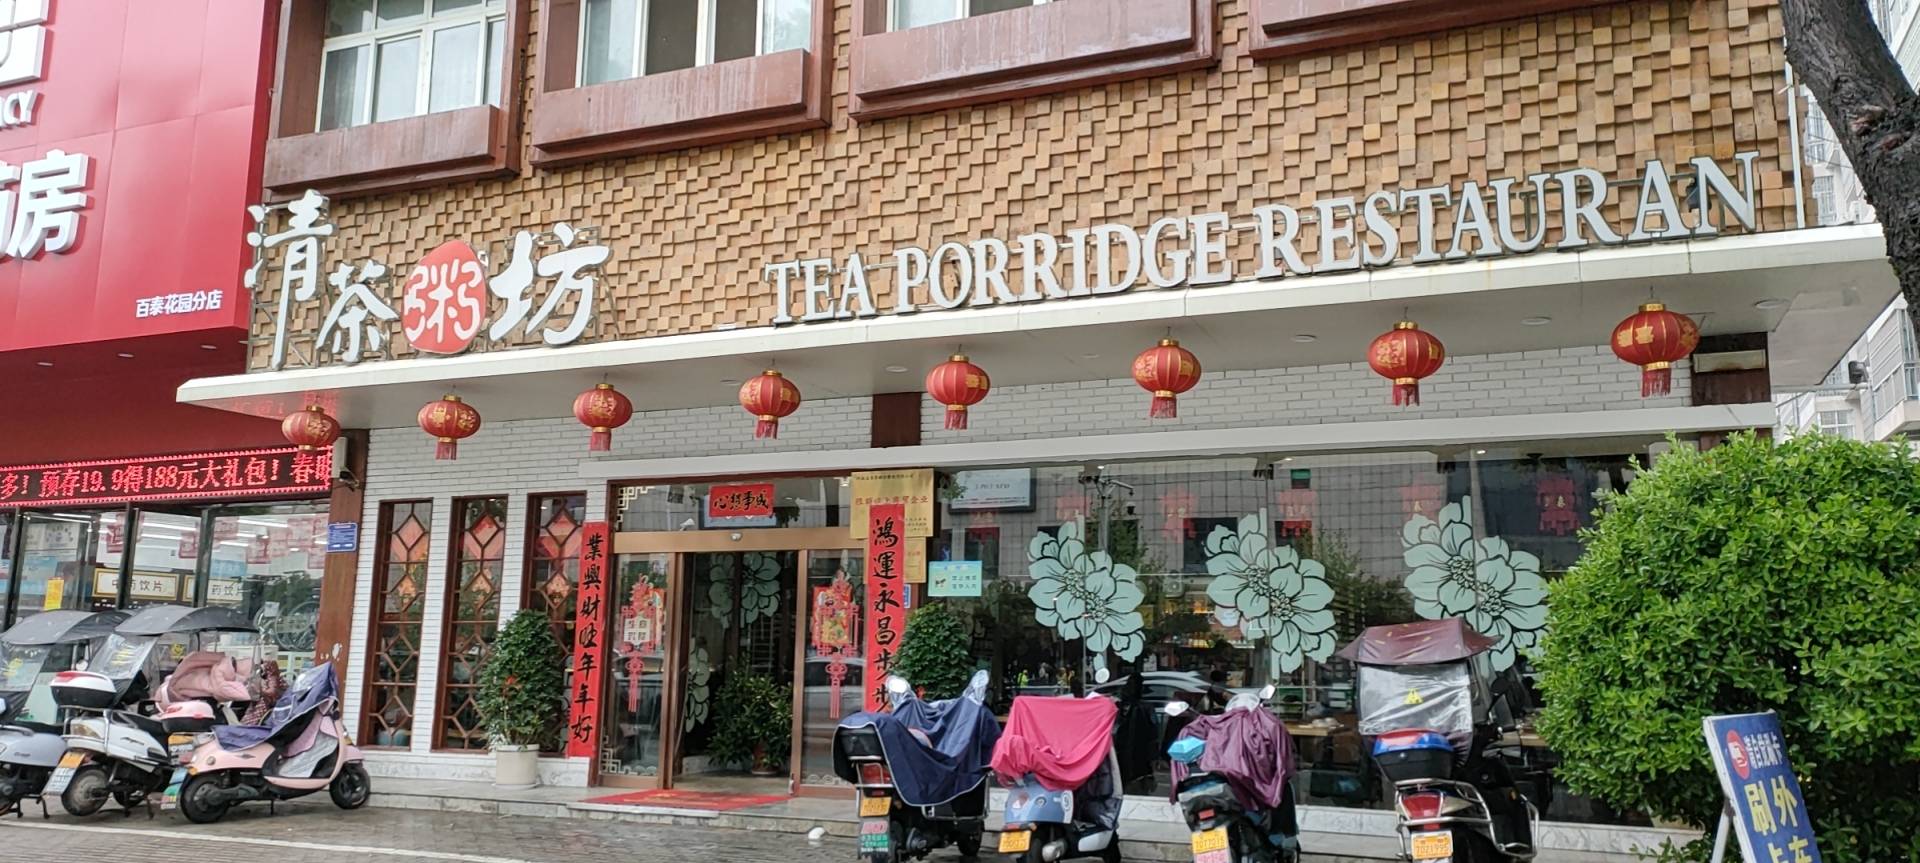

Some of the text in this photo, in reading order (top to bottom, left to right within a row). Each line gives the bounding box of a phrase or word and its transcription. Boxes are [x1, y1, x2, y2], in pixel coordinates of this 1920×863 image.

[0, 90, 37, 127] CY
[765, 151, 1760, 324] TEA PORRIDGE RESTAURAN
[244, 188, 613, 370] 清茶粥坊
[136, 289, 223, 318] 百泰花园分店
[714, 490, 769, 511] 心想事成
